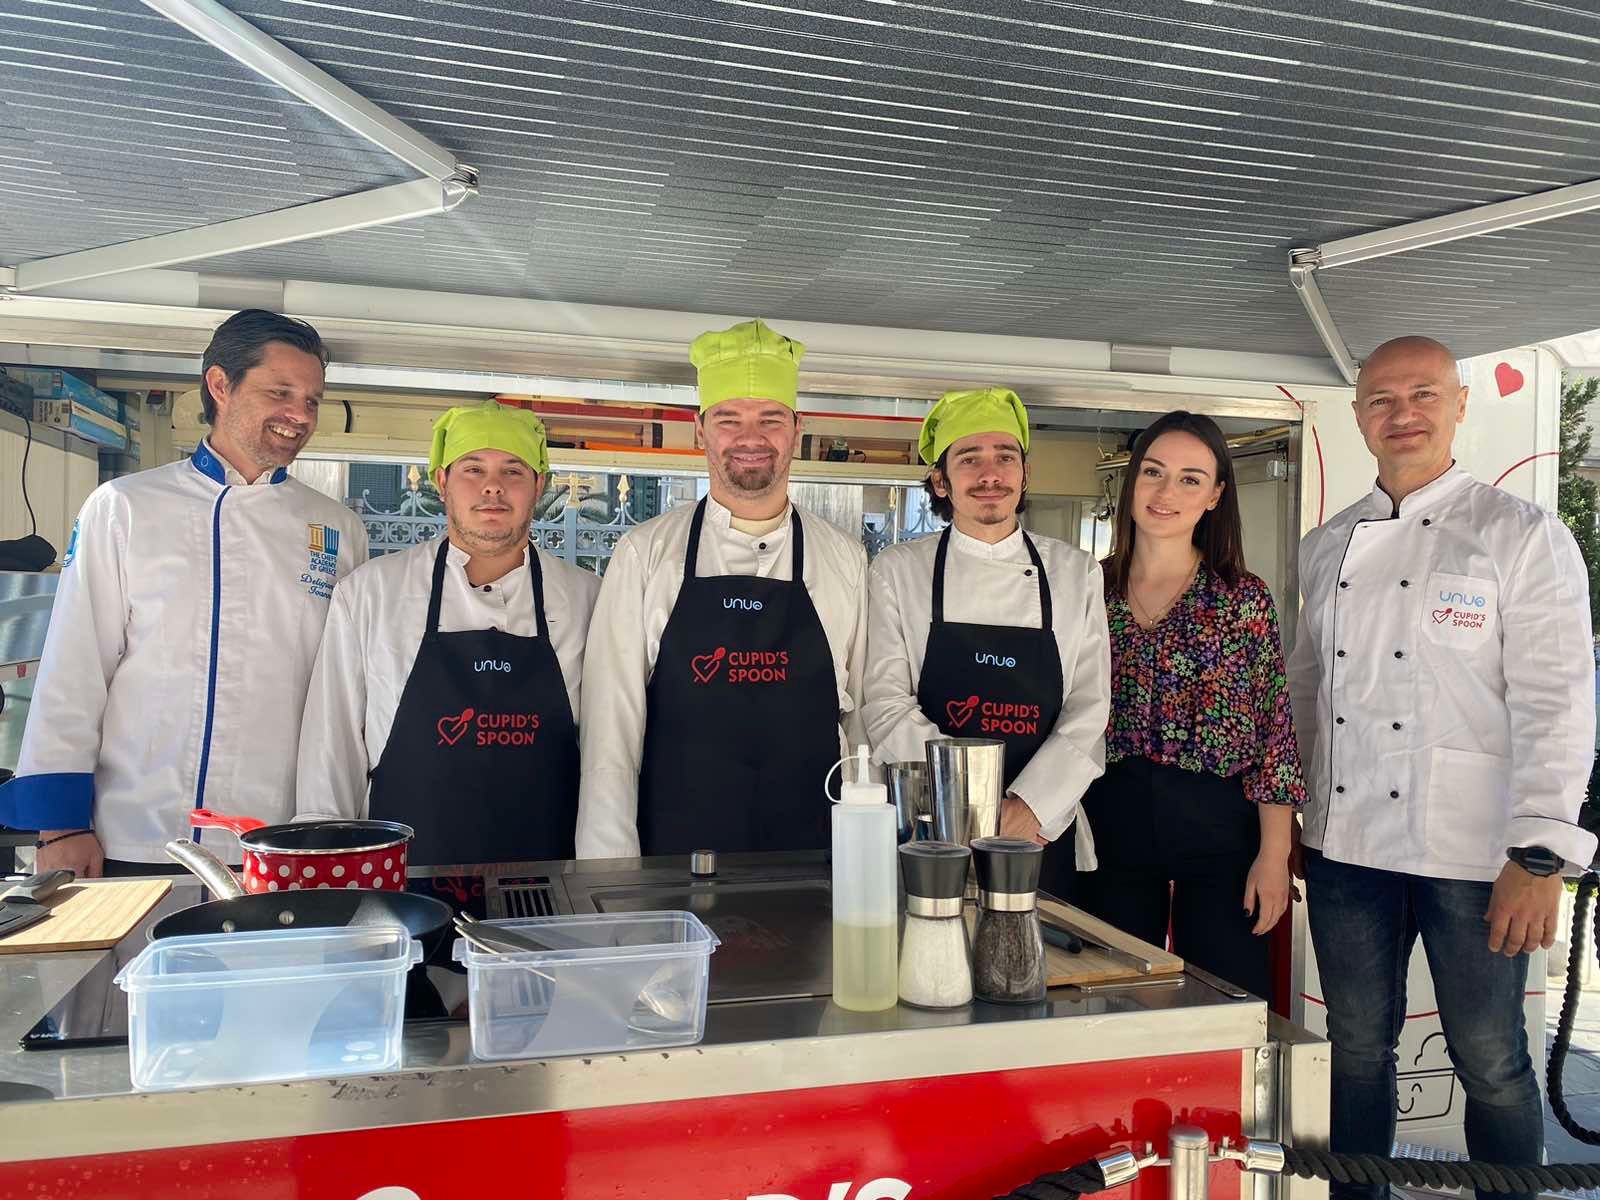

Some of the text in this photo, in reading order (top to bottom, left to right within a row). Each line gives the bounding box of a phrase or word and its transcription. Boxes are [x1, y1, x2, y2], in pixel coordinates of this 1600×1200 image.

[1453, 611, 1486, 622] CUPID'S
[1452, 619, 1483, 629] SPOON
[728, 651, 789, 666] CUPID'S
[728, 668, 786, 682] SPOON
[981, 702, 1040, 719] CUPID'S
[477, 714, 541, 729] CUPID'S
[981, 719, 1037, 735] SPOON
[476, 731, 535, 745] SPOON
